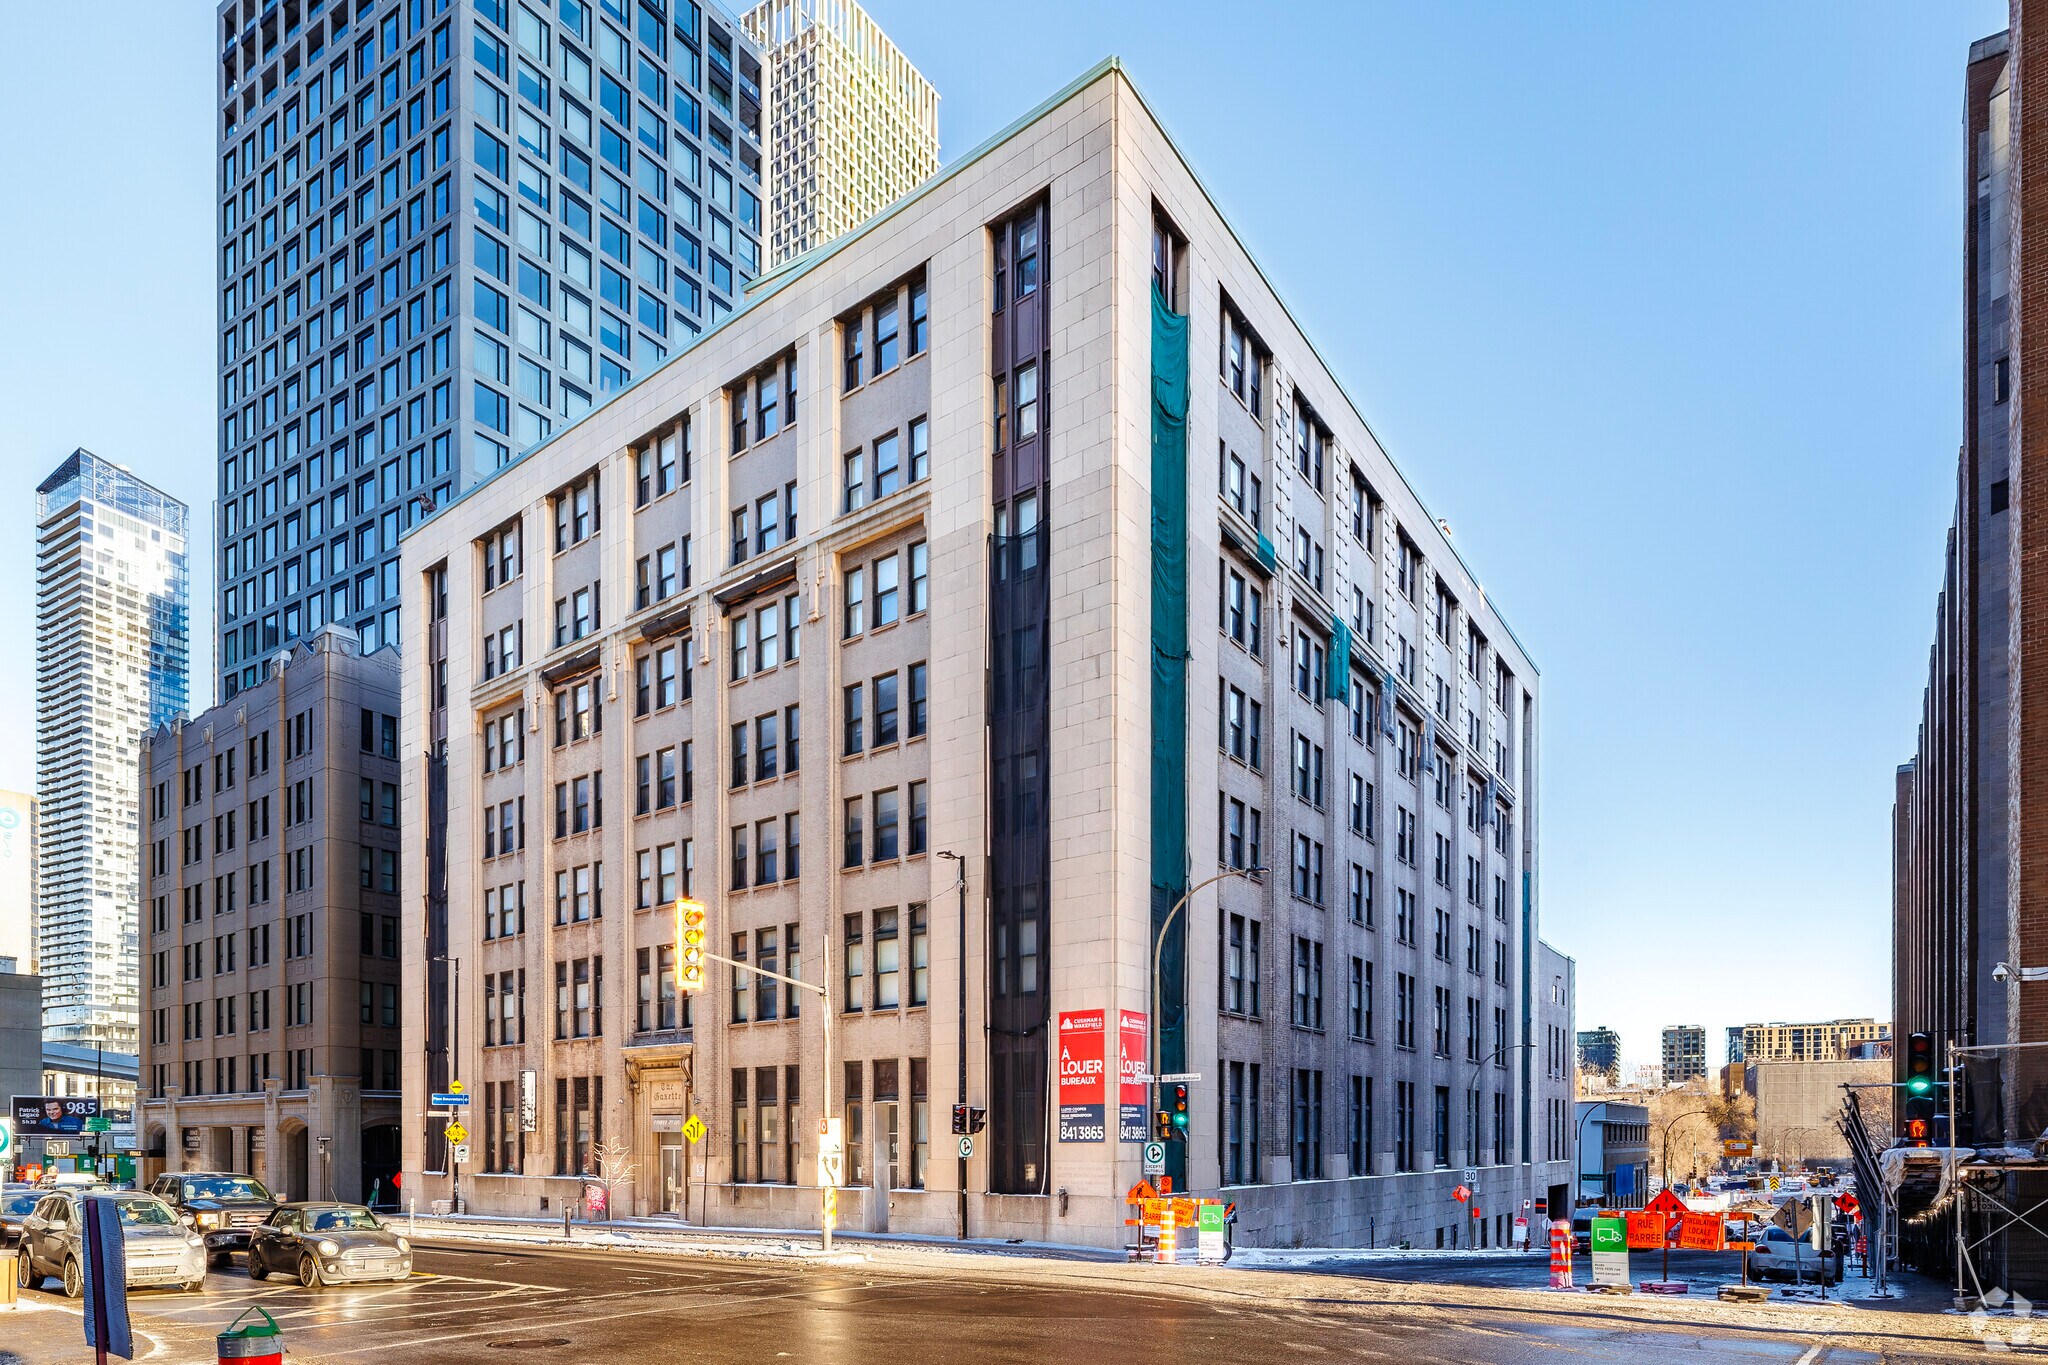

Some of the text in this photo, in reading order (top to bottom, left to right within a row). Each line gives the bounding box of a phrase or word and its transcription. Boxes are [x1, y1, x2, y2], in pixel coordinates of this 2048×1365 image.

[1061, 1045, 1071, 1060] À
[1061, 1060, 1103, 1075] LOUER
[1121, 1060, 1146, 1075] LOUER
[1061, 1076, 1096, 1085] BUREAUX
[654, 1093, 681, 1101] Gazette
[66, 1102, 96, 1115] 98.5
[1465, 1172, 1476, 1181] 30
[1638, 1219, 1653, 1229] RUE
[1684, 1217, 1719, 1226] CIRCULATION
[1689, 1227, 1712, 1236] LOCALE
[1629, 1232, 1661, 1243] BARRÉE
[1683, 1236, 1715, 1246] SEULEMENT
